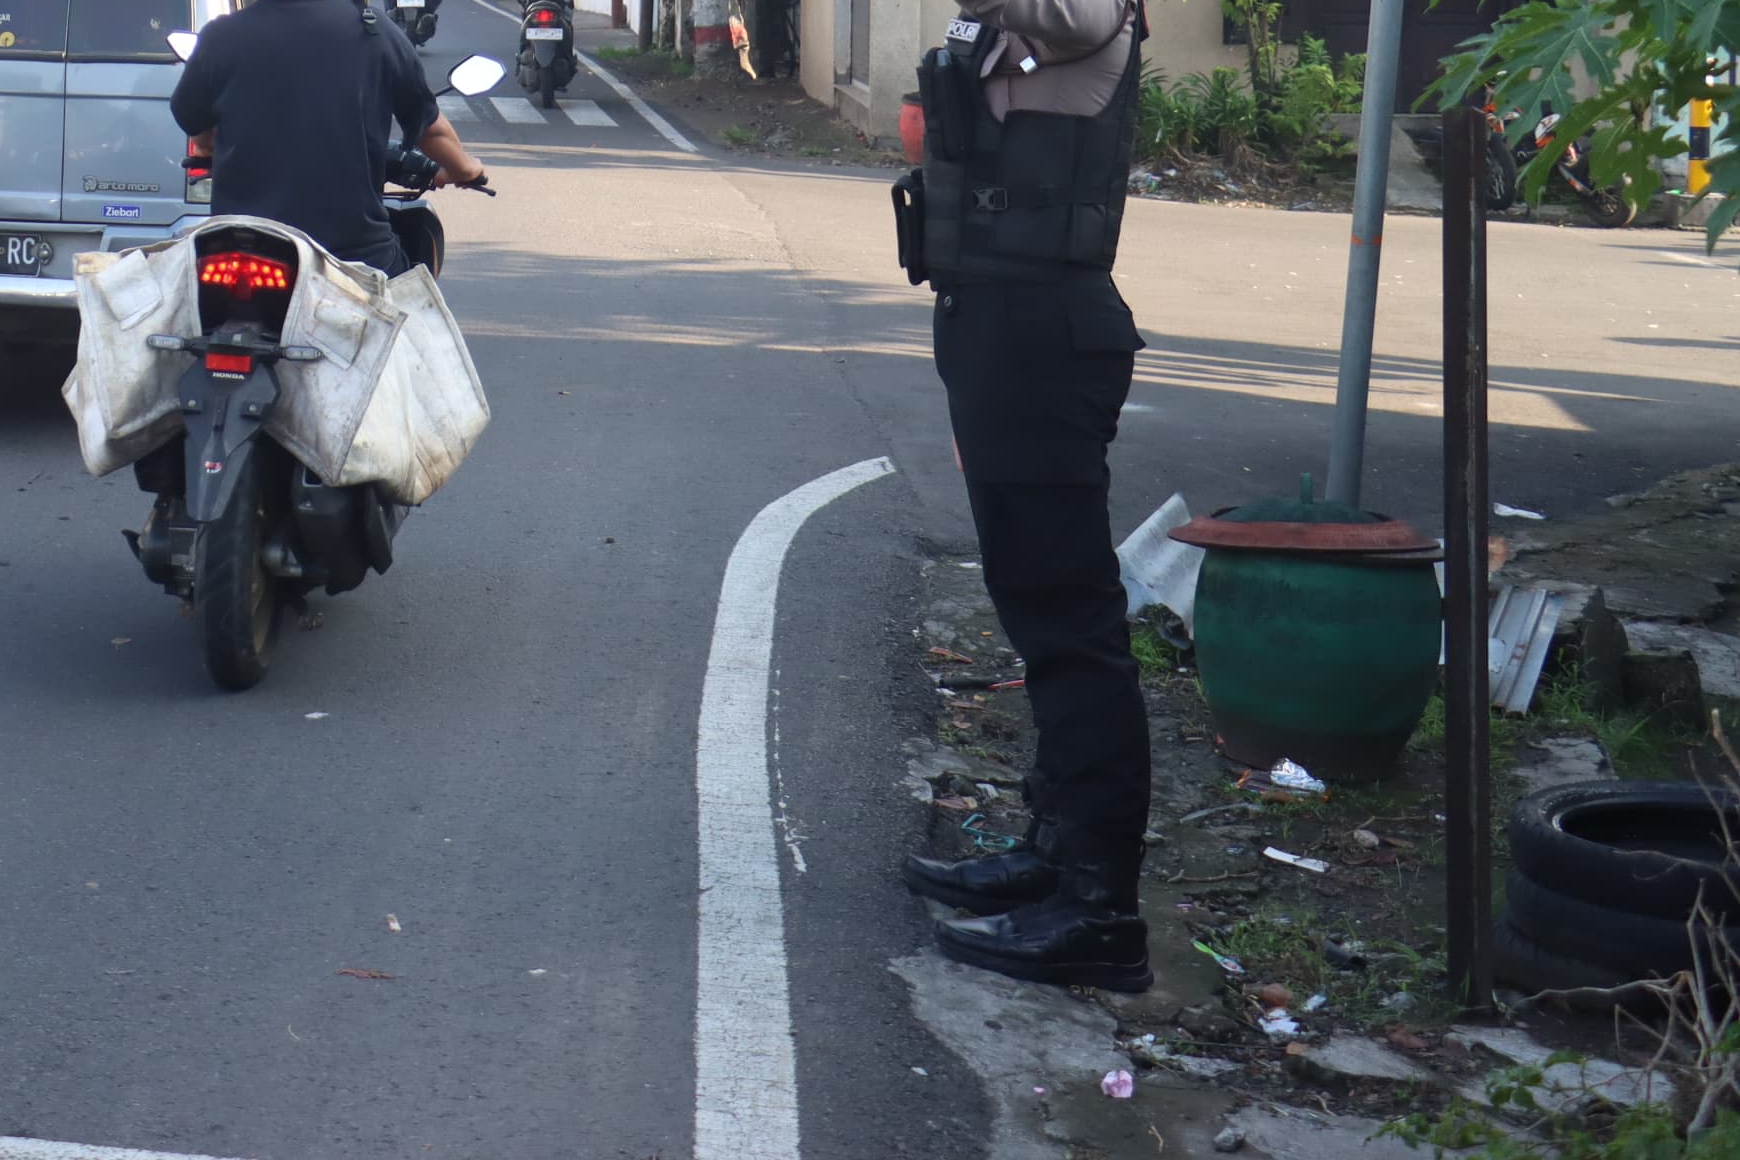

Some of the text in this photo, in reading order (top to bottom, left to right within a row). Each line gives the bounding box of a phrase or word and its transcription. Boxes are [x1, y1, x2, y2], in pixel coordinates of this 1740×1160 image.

[106, 206, 139, 217] Ziebart
[7, 237, 36, 265] RC
[212, 371, 245, 380] HONDA
